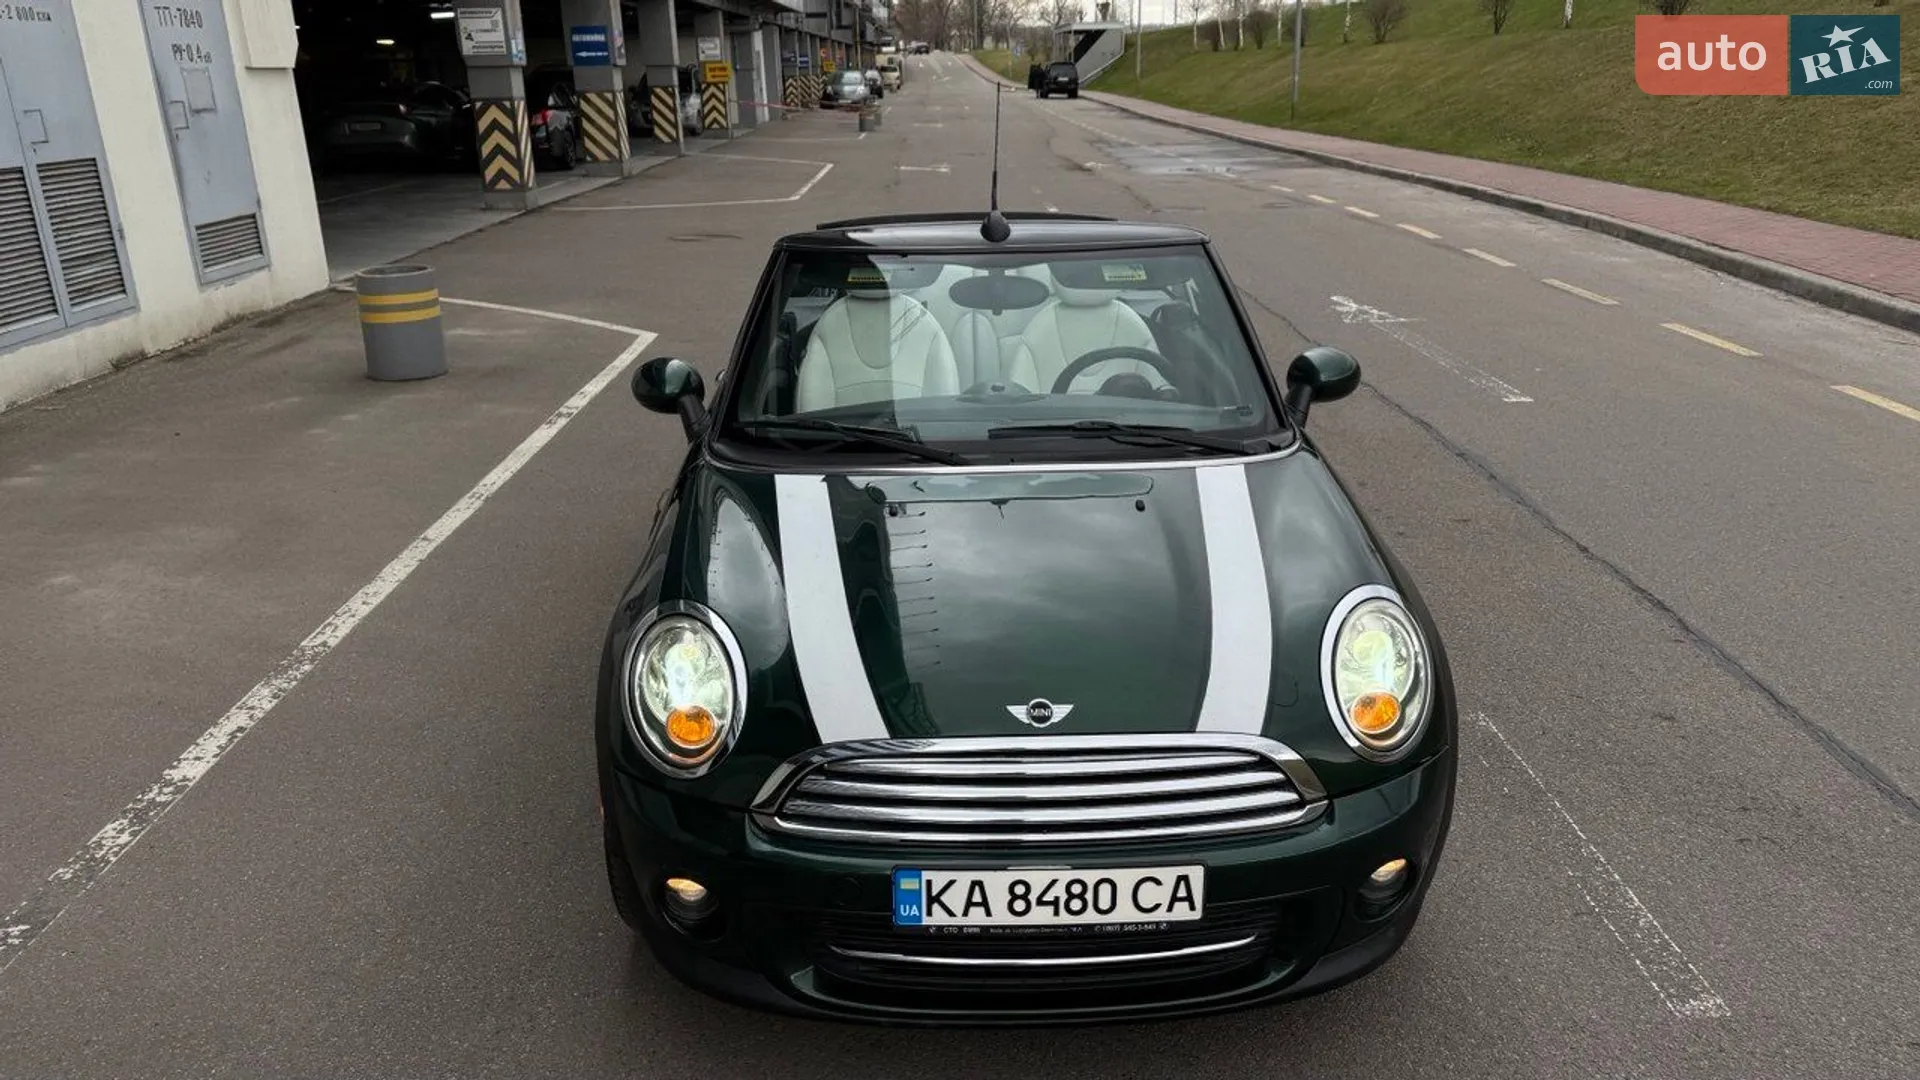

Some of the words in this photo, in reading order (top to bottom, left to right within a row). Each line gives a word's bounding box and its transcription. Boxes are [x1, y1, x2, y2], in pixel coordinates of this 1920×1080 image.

[1030, 708, 1051, 717] MINI
[925, 878, 993, 918] KA
[1007, 877, 1117, 917] 8480
[1131, 874, 1197, 914] CA
[900, 905, 920, 917] UA
